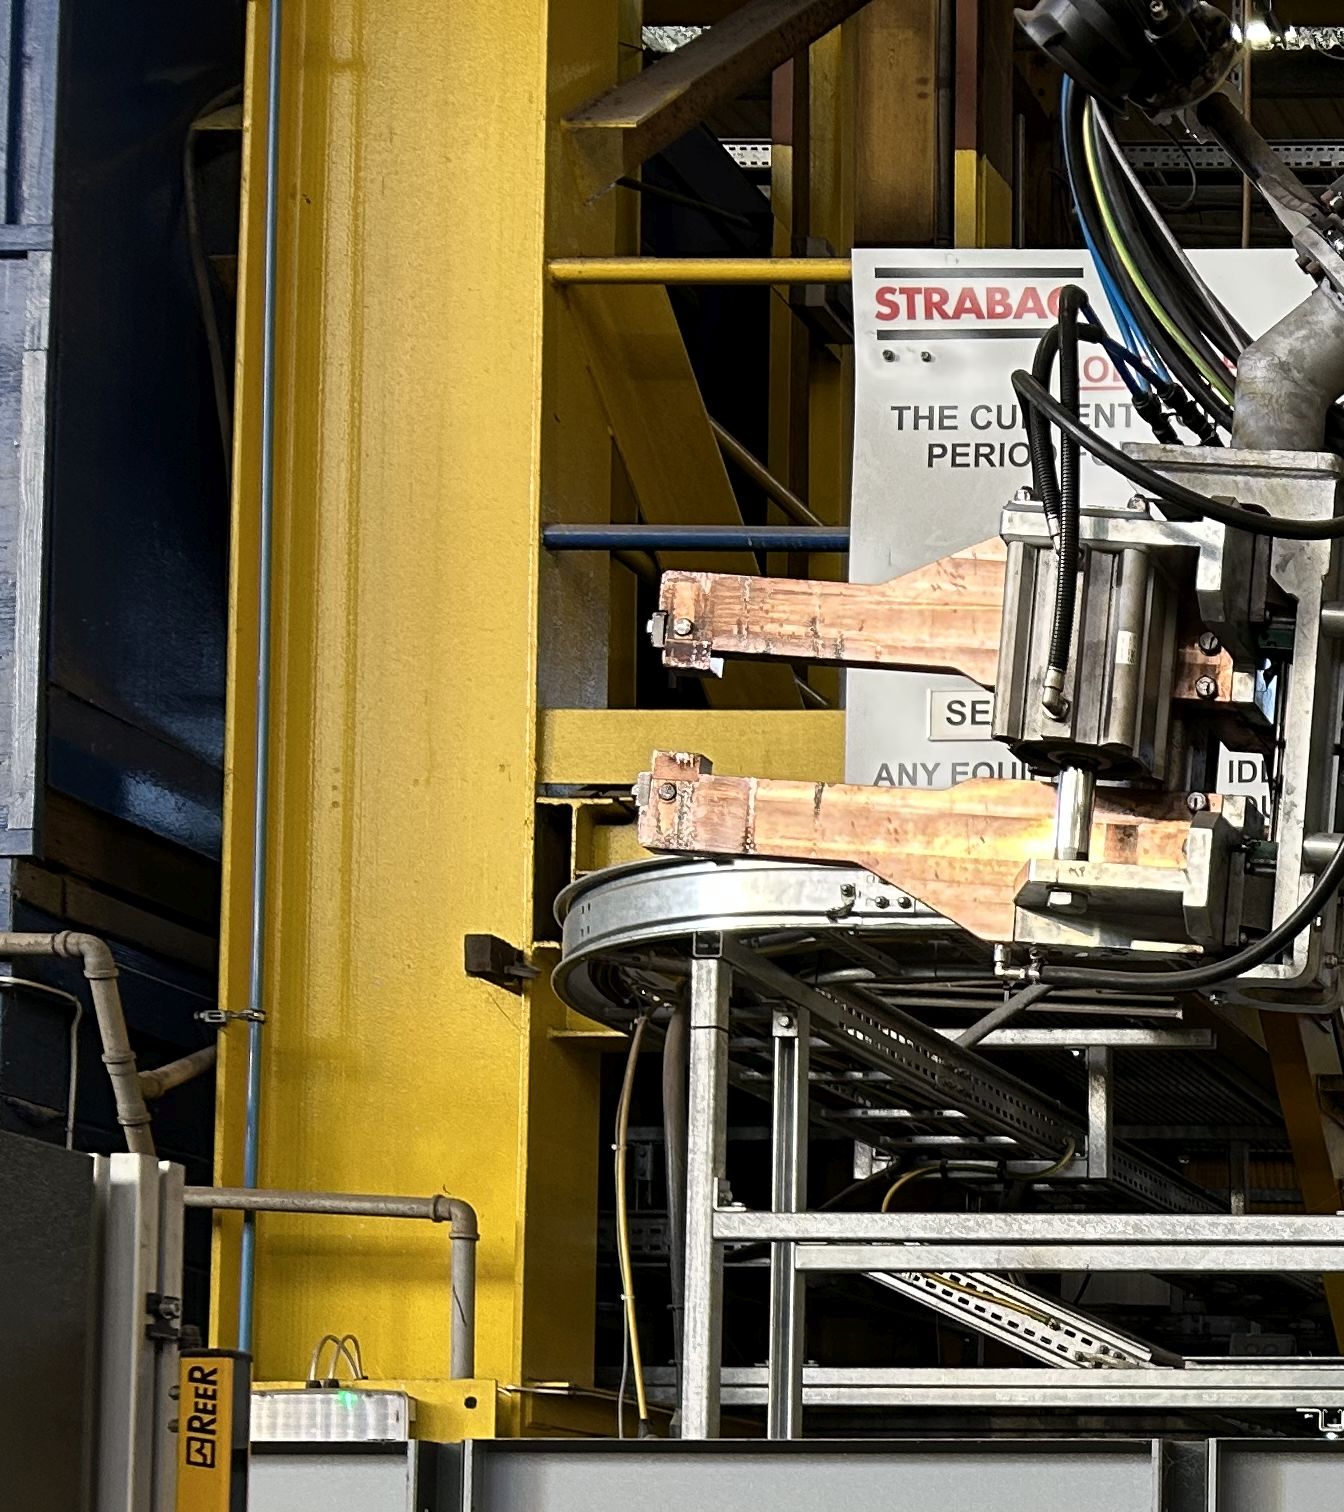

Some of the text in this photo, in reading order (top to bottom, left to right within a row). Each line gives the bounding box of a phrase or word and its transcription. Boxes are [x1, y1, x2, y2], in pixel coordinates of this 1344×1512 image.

[891, 405, 958, 431] THE
[971, 404, 1133, 430] CUENT
[928, 443, 1050, 467] PERIO
[873, 762, 941, 786] ANY
